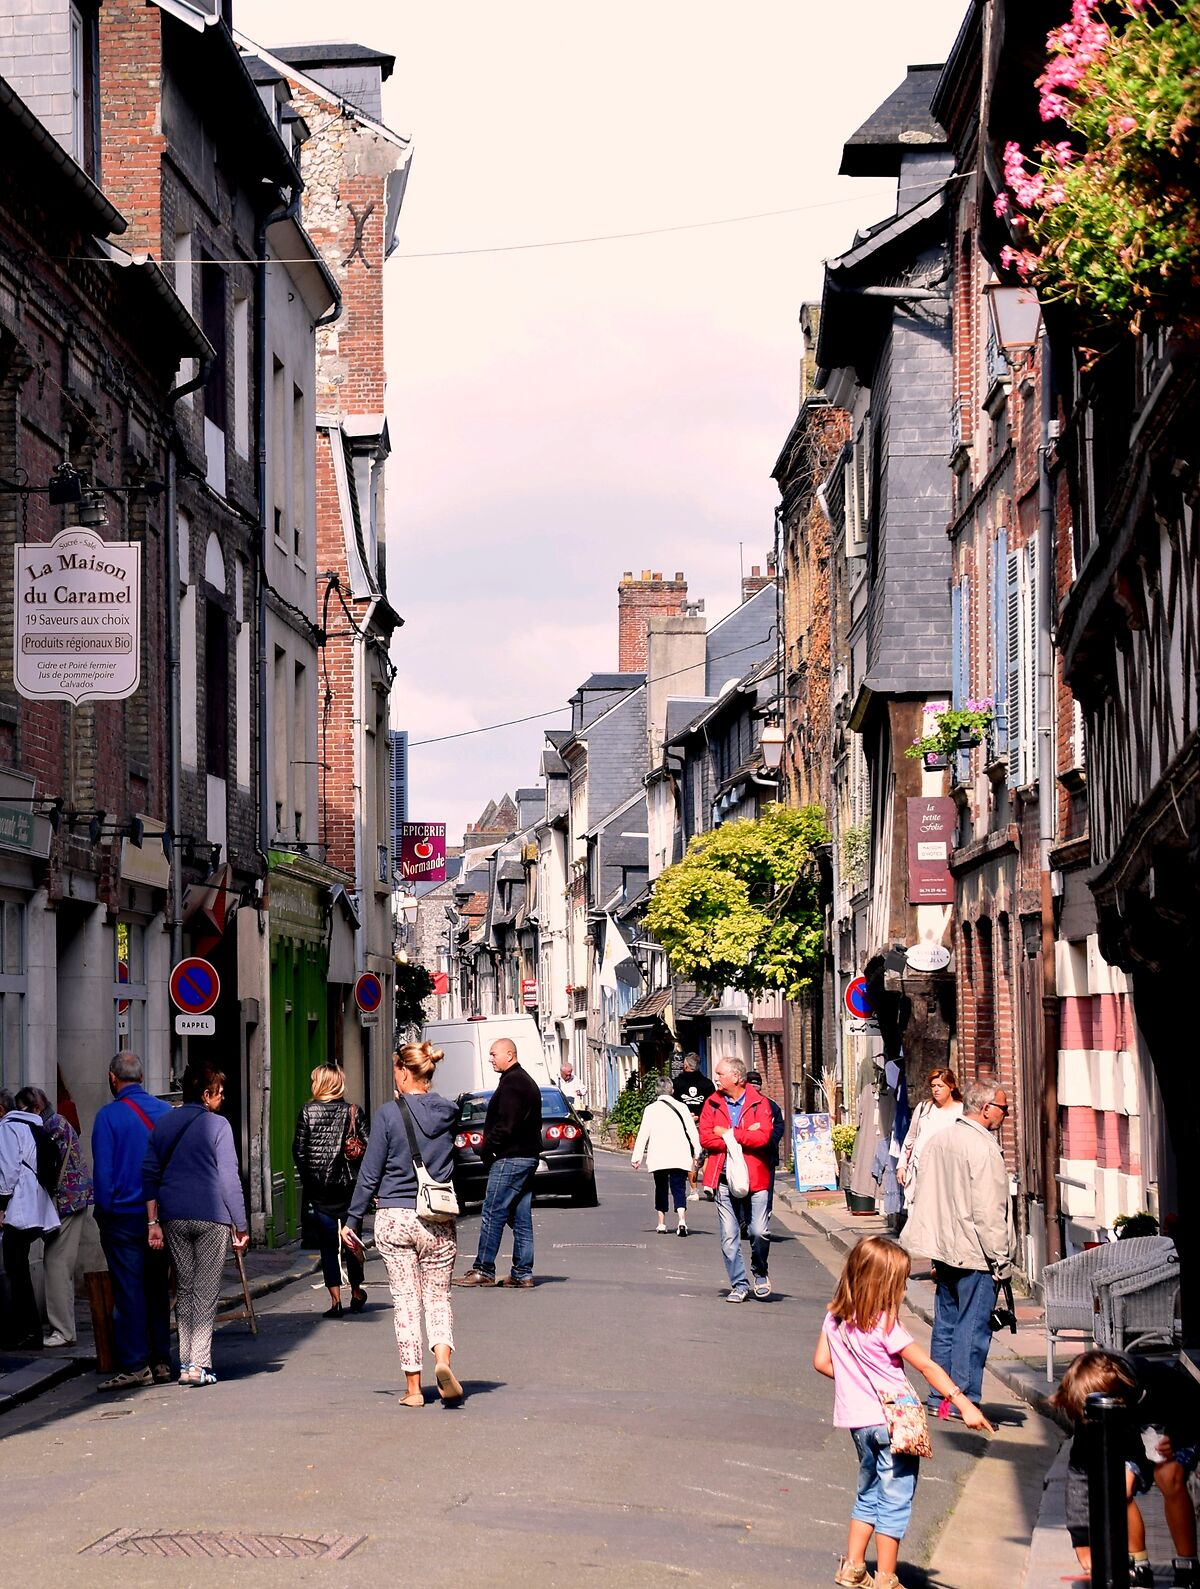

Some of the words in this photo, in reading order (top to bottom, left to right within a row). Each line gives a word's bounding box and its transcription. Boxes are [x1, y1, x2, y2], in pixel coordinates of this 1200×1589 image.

[58, 539, 78, 550] Sucré
[84, 540, 97, 550] Salé
[25, 561, 53, 581] La
[56, 553, 127, 581] Maison
[24, 586, 47, 604] du
[54, 586, 132, 604] Caramel
[25, 614, 37, 625] 19
[39, 614, 79, 625] Saveurs
[80, 616, 100, 625] aux
[101, 613, 130, 625] choix
[25, 637, 64, 649] Produits
[66, 636, 113, 652] régionaux
[114, 637, 130, 649] Bio
[37, 661, 58, 670] Cidre
[59, 662, 67, 670] et
[68, 661, 88, 670] Poiré
[89, 661, 117, 670] fermier
[38, 671, 51, 680] Jus
[51, 671, 62, 679] de
[63, 671, 115, 681] pomme/poire
[59, 680, 94, 688] Calvados
[921, 814, 941, 823] petite
[403, 825, 445, 837] EPICERIE
[402, 853, 445, 876] Normande
